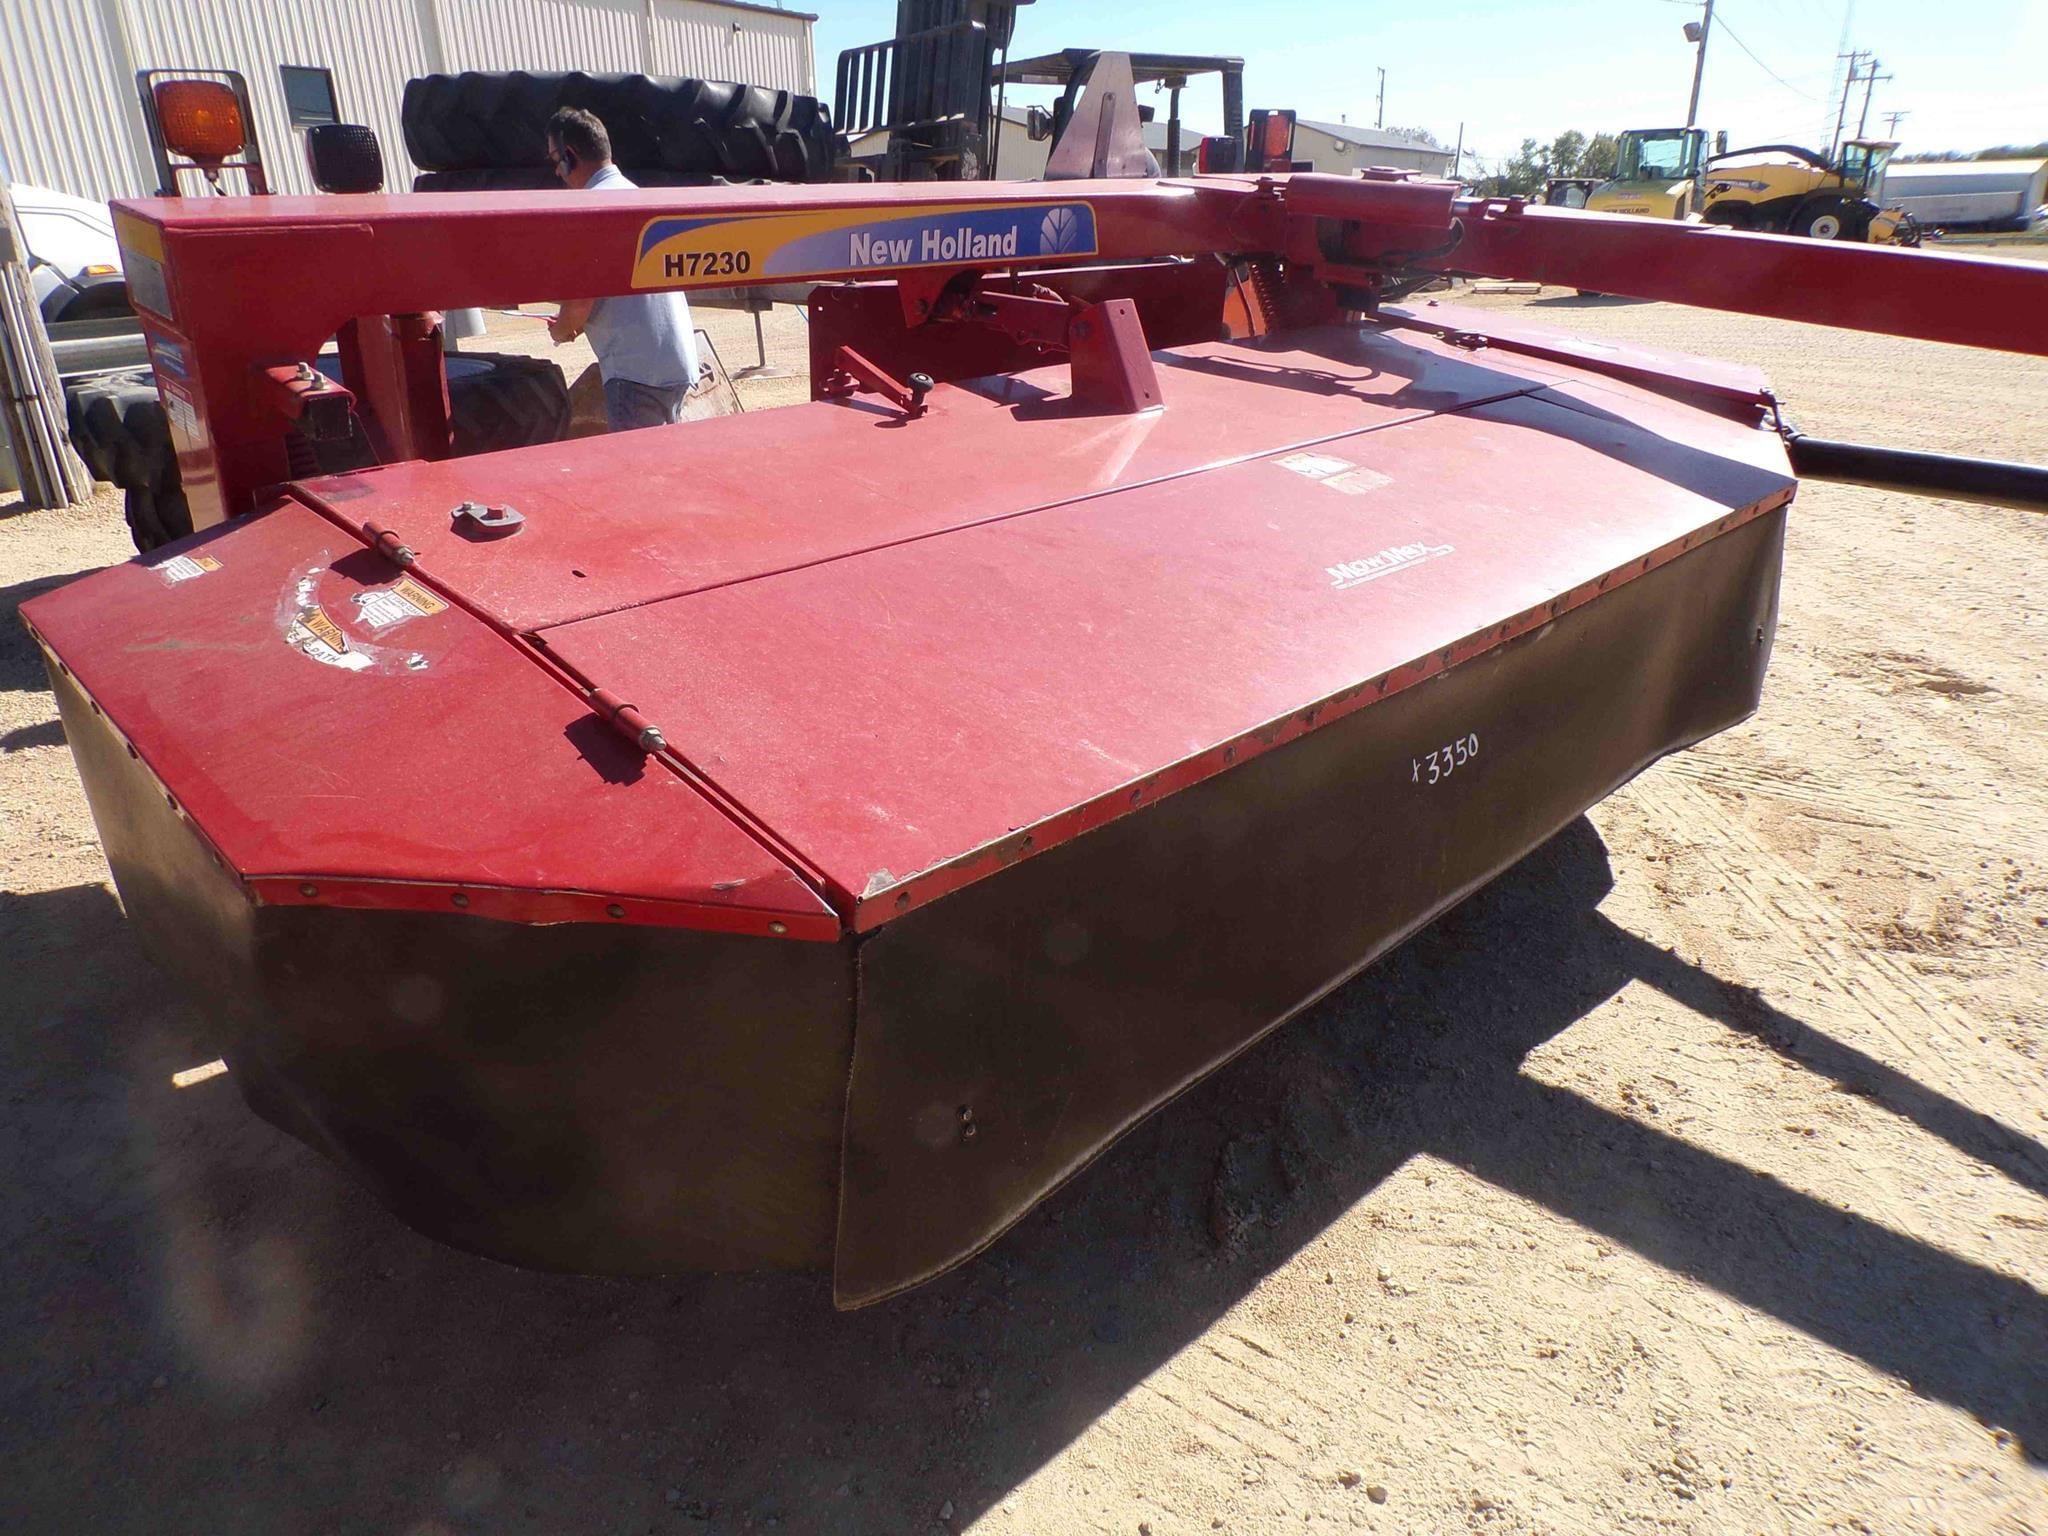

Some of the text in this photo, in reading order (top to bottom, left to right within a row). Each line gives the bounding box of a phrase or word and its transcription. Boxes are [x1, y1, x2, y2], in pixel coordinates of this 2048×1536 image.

[850, 224, 1017, 266] New Holland
[664, 250, 751, 277] H7230
[400, 586, 436, 610] WARNING
